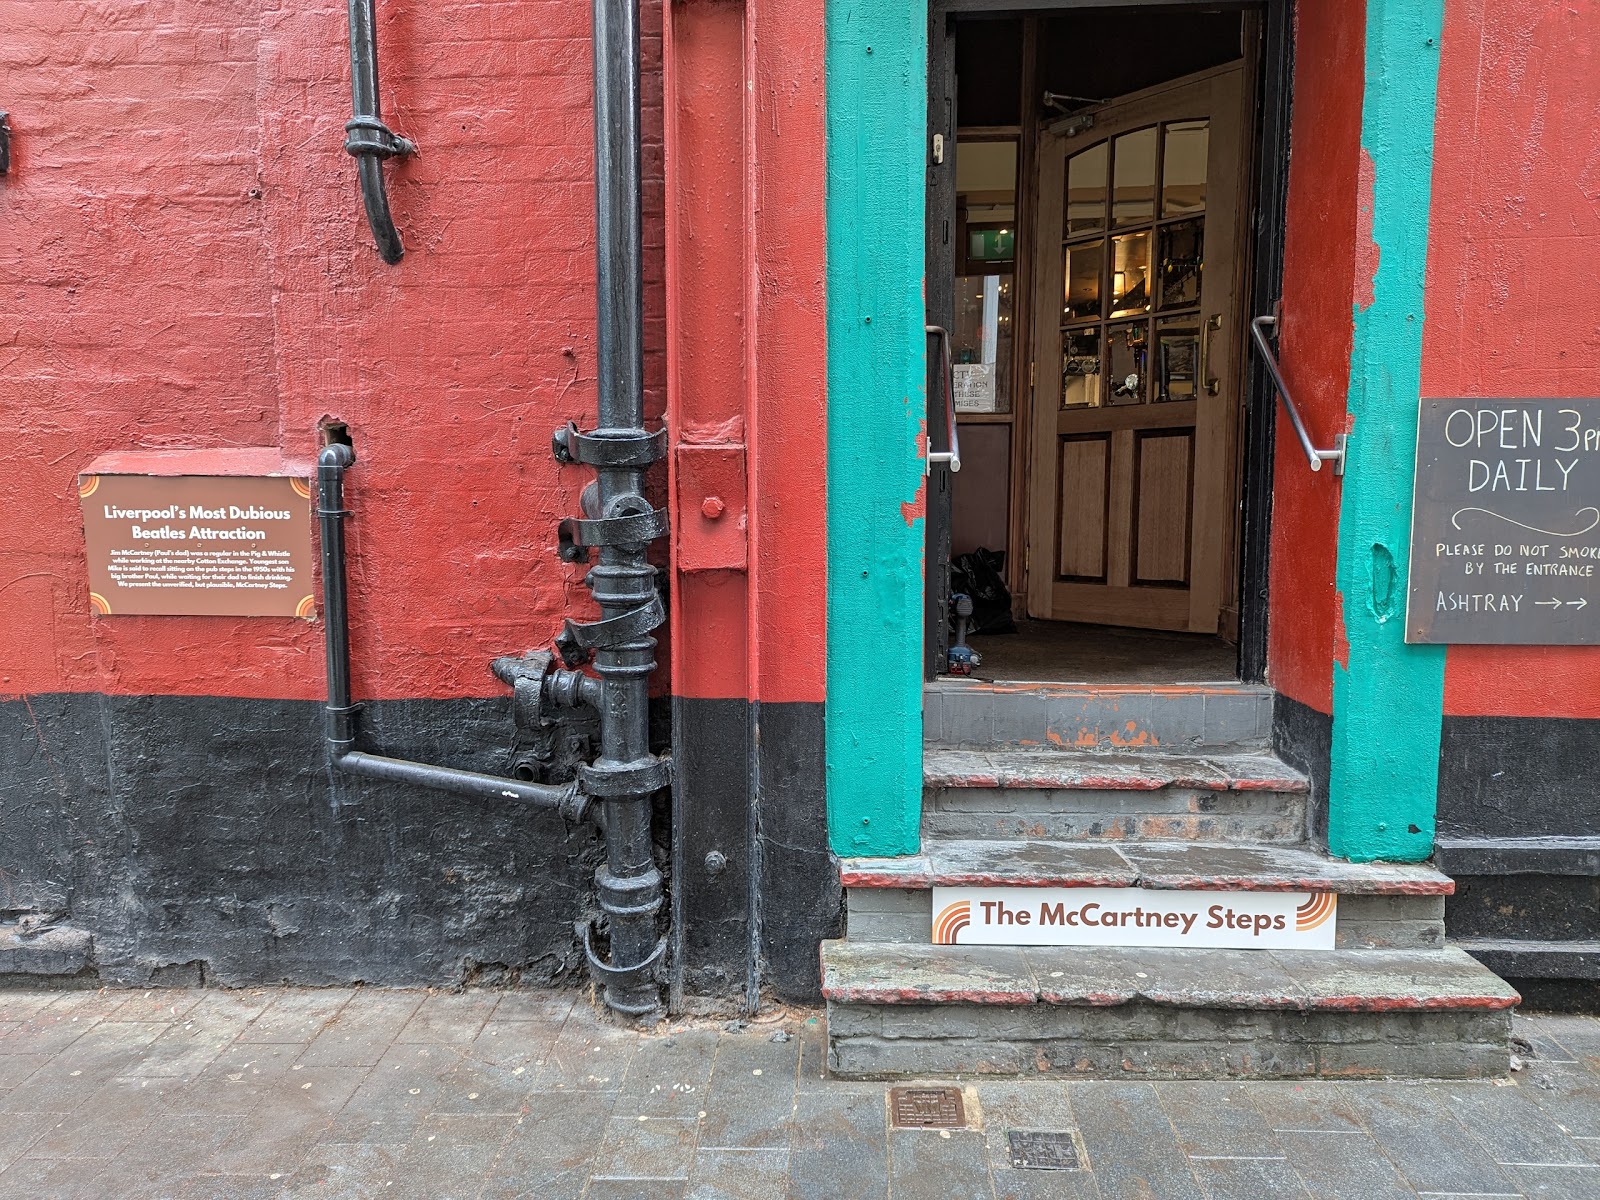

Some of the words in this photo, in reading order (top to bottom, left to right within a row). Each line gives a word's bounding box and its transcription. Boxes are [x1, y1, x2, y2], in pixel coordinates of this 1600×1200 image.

[1445, 409, 1542, 449] OPEN
[1468, 458, 1579, 492] DAILY
[104, 505, 186, 522] Liverpool's
[190, 506, 226, 520] Most
[230, 506, 290, 520] Dubious
[132, 526, 186, 539] Beatles
[189, 526, 266, 540] Attraction
[1436, 543, 1485, 557] PLEASE
[1494, 544, 1512, 556] DO
[1519, 544, 1550, 557] NOT
[1465, 562, 1484, 575] BY
[1494, 562, 1517, 575] THE
[1526, 562, 1594, 577] ENTRANCE
[1436, 590, 1523, 612] ASHTRAY
[980, 901, 1030, 926] The
[1039, 902, 1198, 935] McCartney
[1206, 904, 1286, 936] Steps
